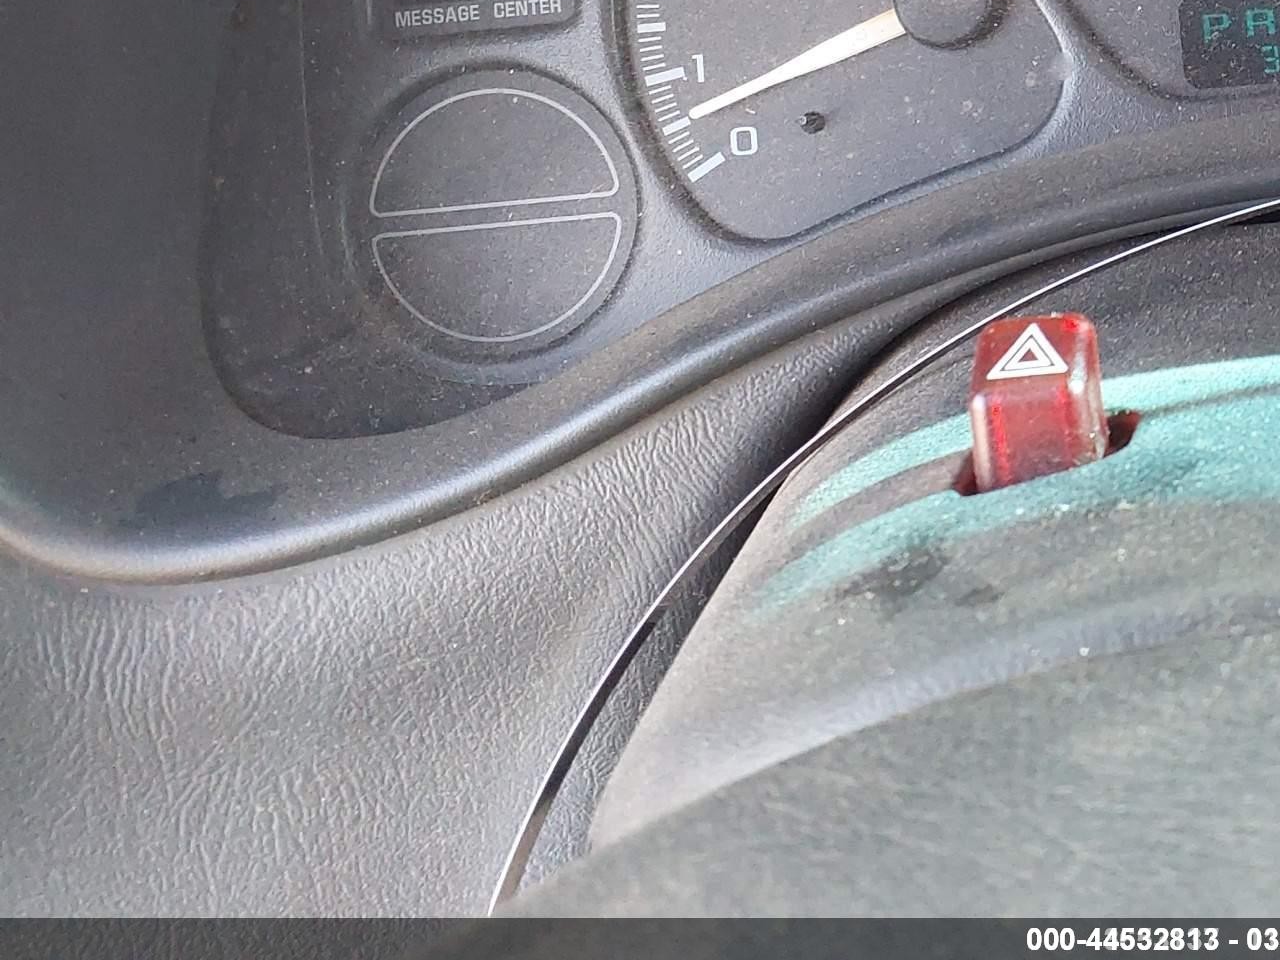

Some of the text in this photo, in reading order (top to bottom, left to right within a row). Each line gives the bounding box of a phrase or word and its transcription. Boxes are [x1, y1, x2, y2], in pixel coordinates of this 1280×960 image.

[395, 4, 480, 28] MESSAGE
[691, 54, 706, 82] 1
[730, 127, 759, 156] 0
